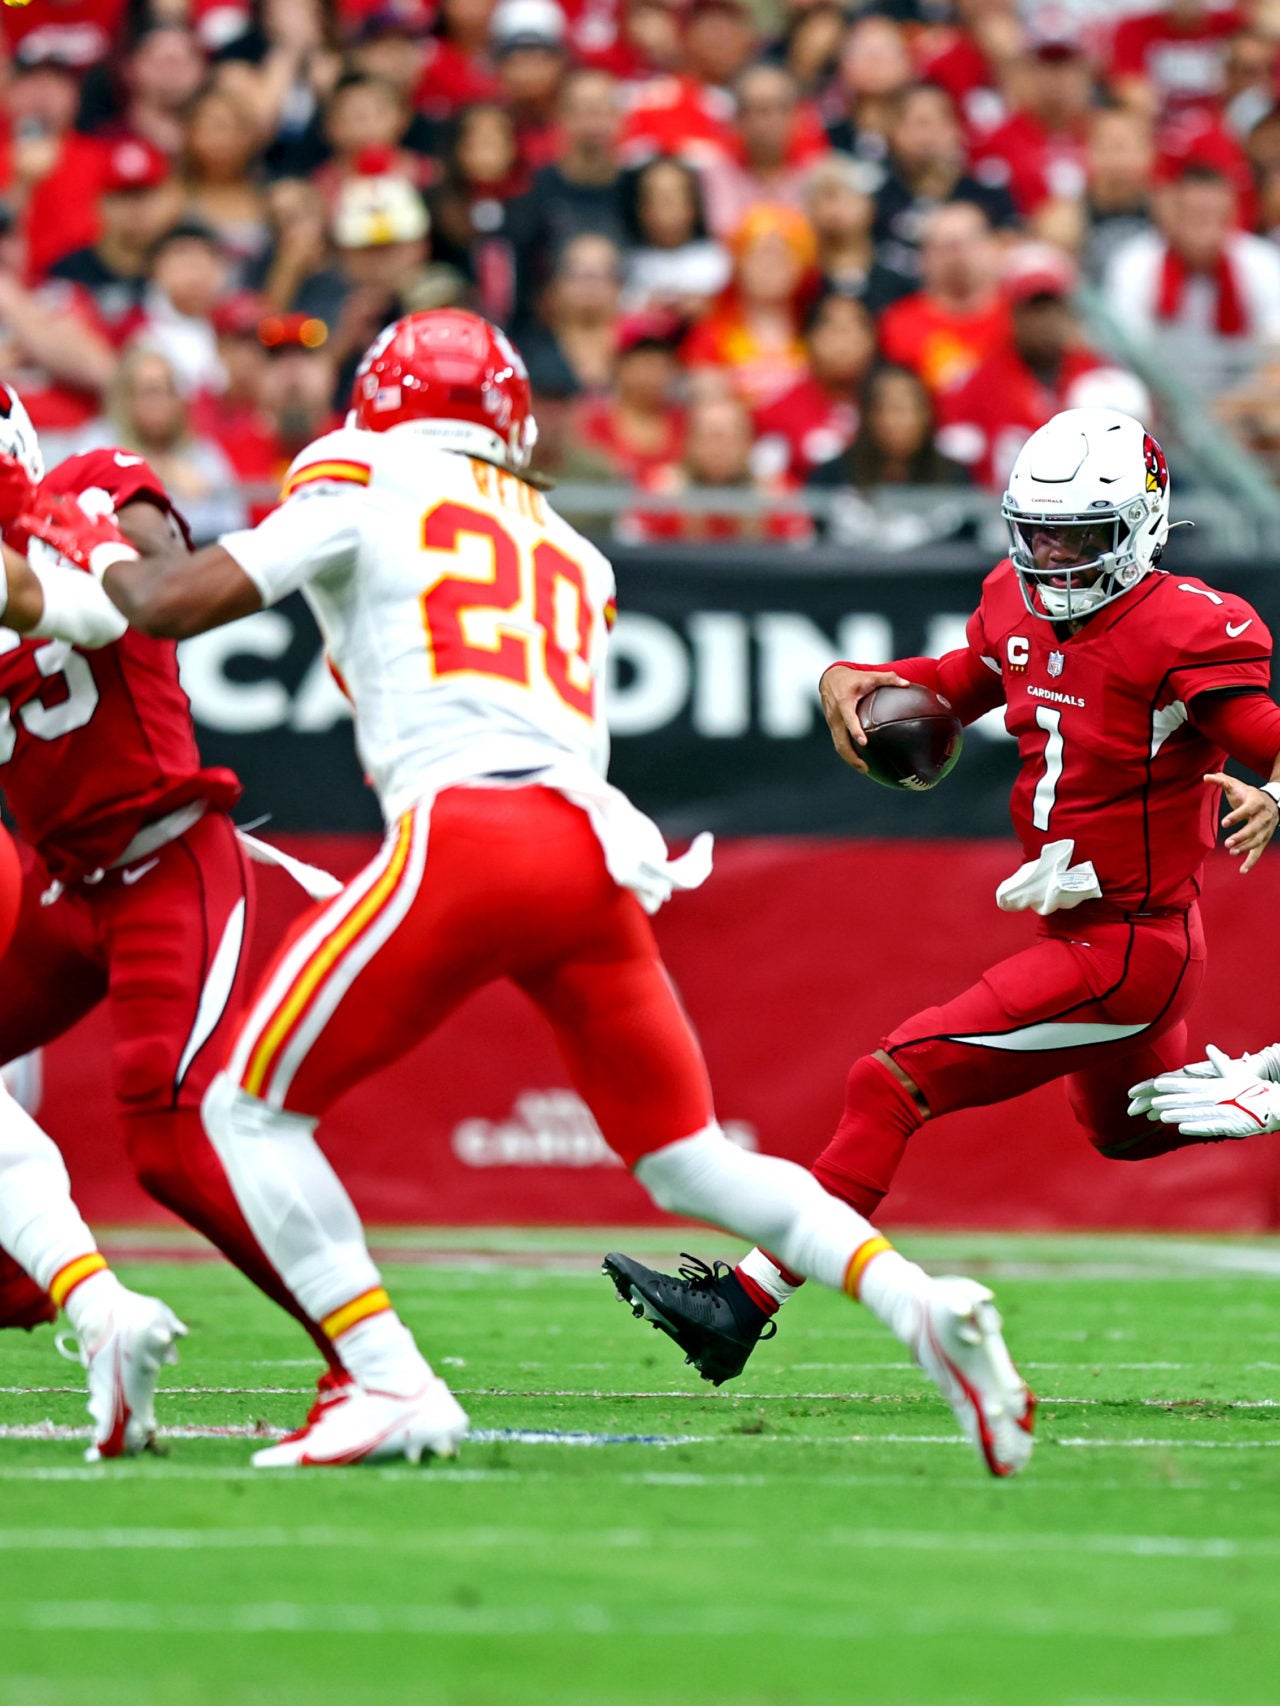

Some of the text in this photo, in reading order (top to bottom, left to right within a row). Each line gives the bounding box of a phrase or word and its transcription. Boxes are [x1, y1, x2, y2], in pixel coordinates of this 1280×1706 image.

[1177, 582, 1224, 606] 1
[418, 496, 596, 727] 20
[1006, 635, 1030, 665] C
[1026, 685, 1085, 707] CARDINALS
[1032, 704, 1064, 832] 1
